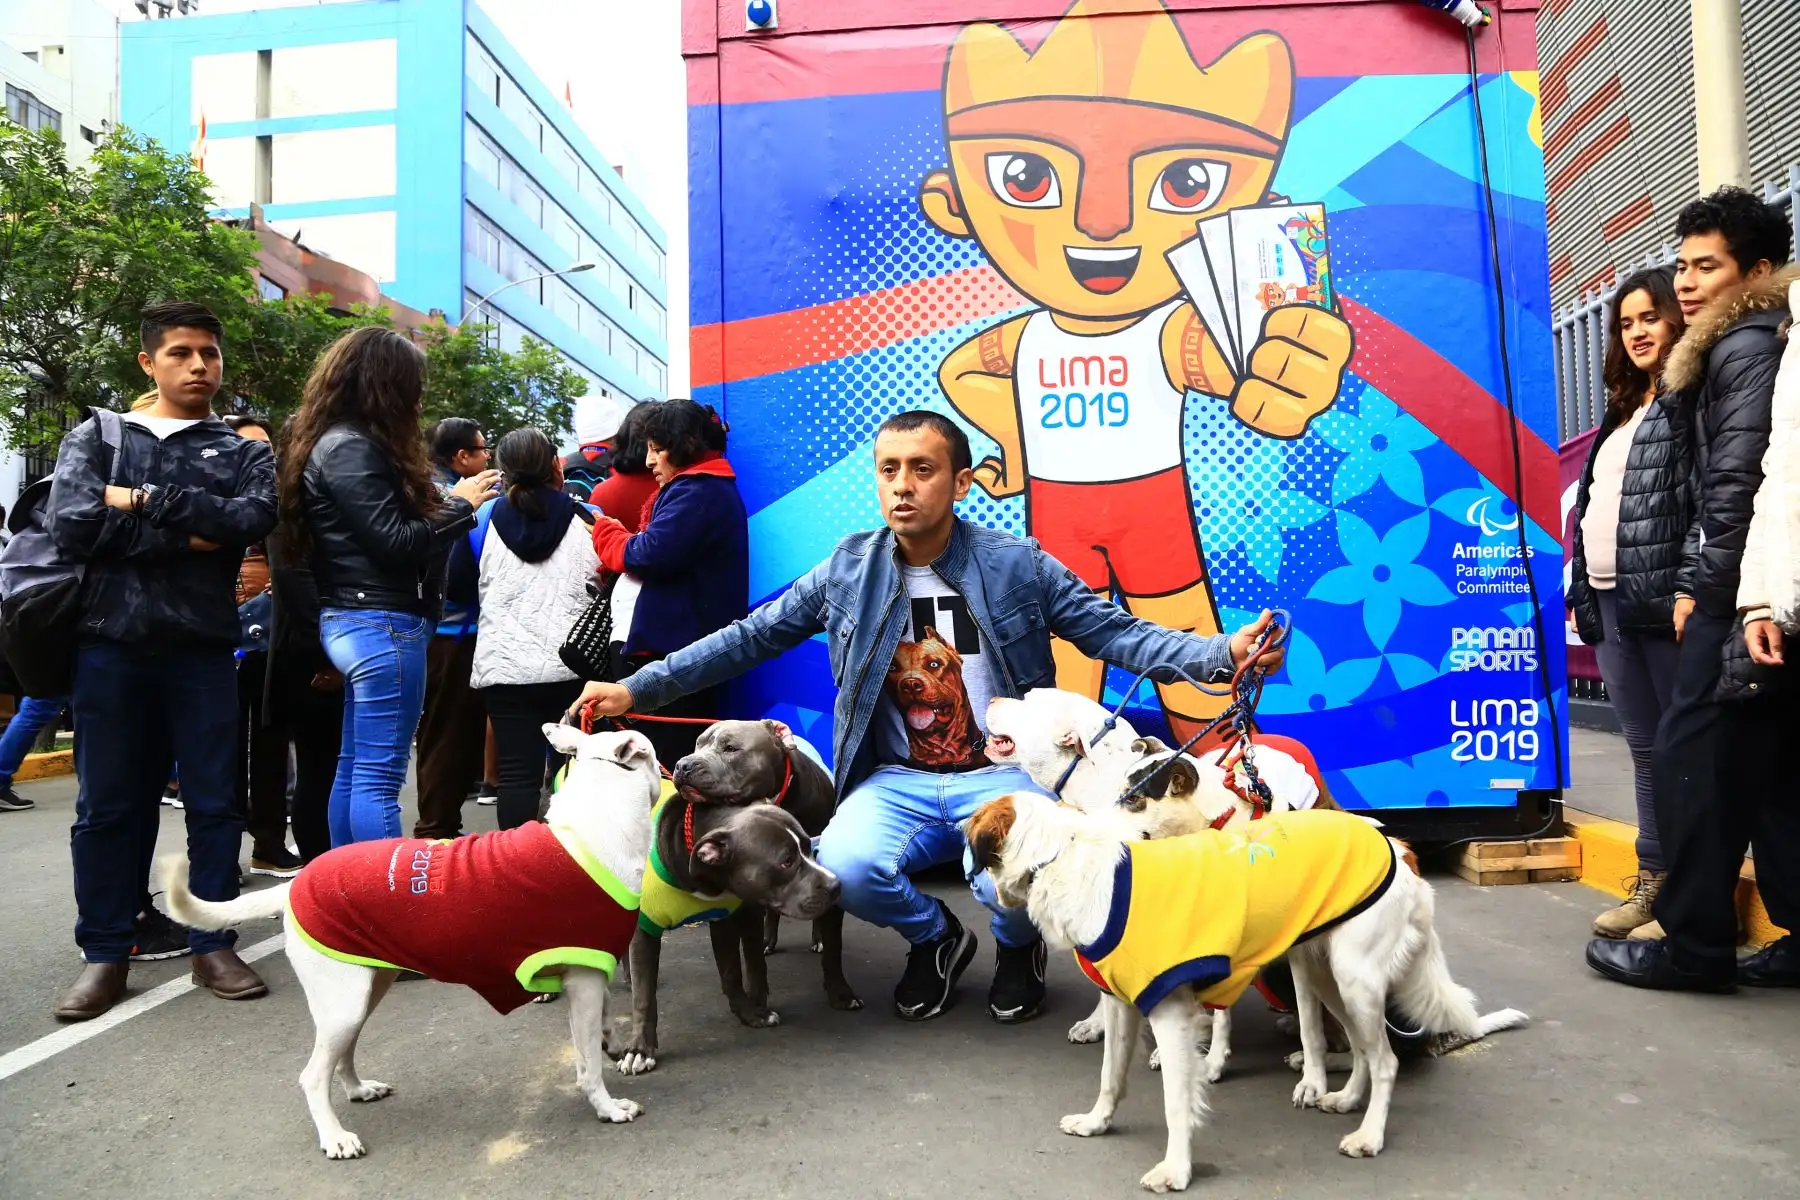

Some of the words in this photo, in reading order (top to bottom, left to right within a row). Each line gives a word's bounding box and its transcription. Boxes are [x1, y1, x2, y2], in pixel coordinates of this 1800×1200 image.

[1041, 392, 1129, 428] 2019
[1452, 542, 1534, 559] Americas
[1457, 581, 1531, 594] Committee
[1452, 627, 1535, 648] PANAM
[1450, 650, 1538, 671] SPORTS
[1451, 730, 1538, 761] 2019
[411, 850, 432, 894] 2019
